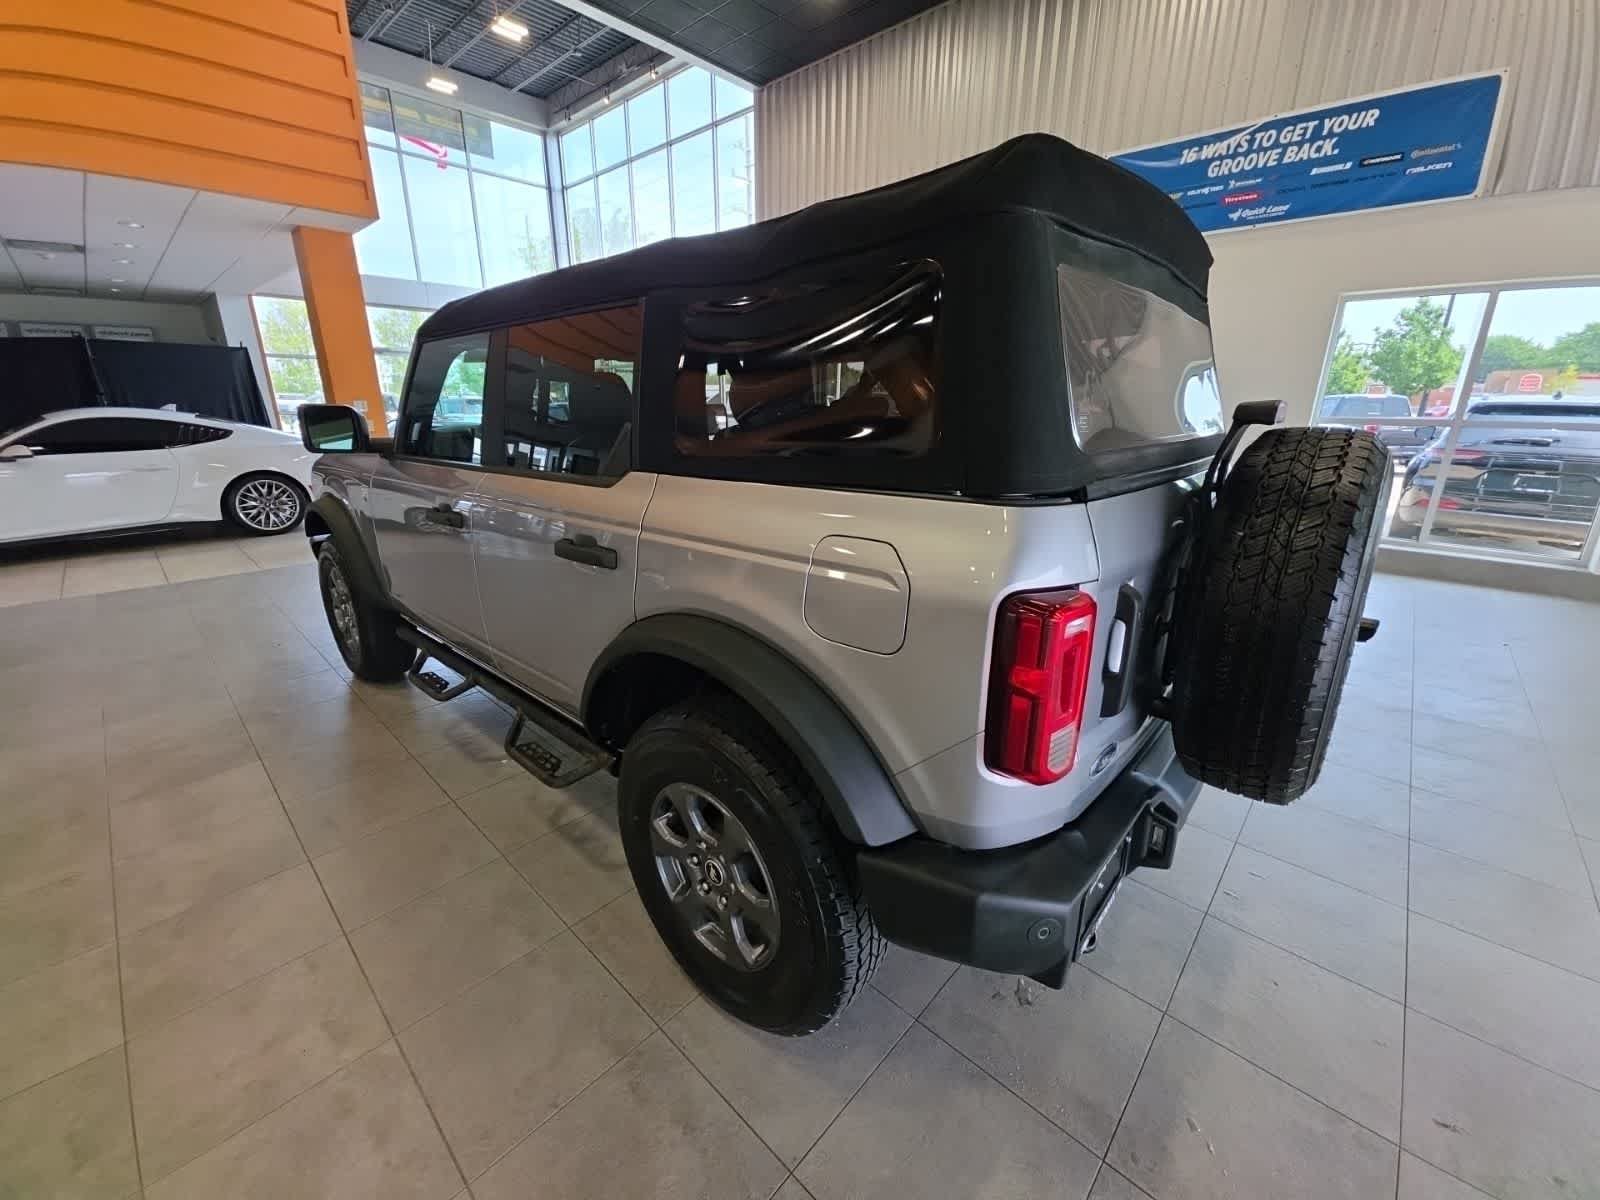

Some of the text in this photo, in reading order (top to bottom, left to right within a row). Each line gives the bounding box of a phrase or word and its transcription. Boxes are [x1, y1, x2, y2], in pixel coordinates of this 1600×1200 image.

[1179, 108, 1380, 165] 16 WAYS TO GET YOUR
[1207, 149, 1282, 178] GROOVE
[1282, 137, 1341, 164] BACK.
